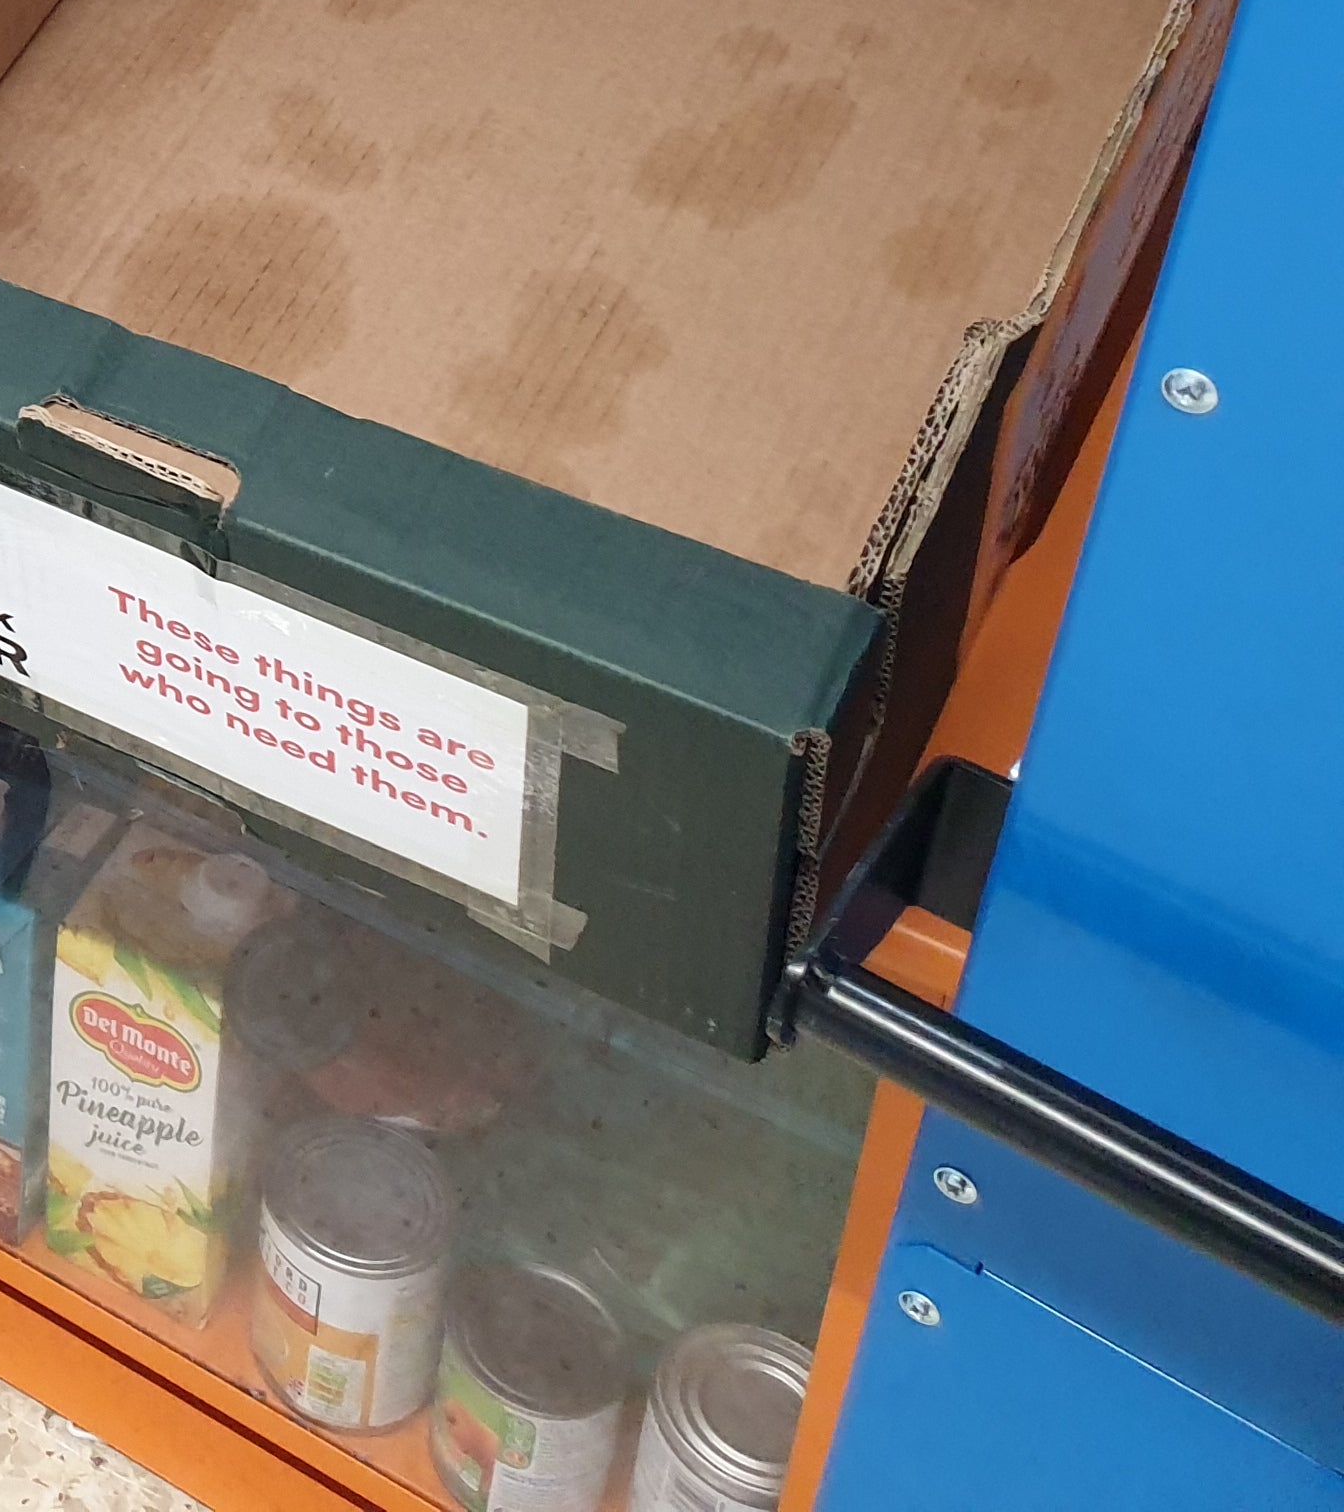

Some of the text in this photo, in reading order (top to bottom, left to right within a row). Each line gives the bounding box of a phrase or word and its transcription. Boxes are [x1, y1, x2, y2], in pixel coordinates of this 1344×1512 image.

[108, 586, 496, 770] These things are
[118, 662, 489, 840] who need them.
[136, 639, 468, 795] going to those
[83, 1006, 193, 1076] Del Monte
[56, 1079, 204, 1147] Pineapple
[91, 1076, 135, 1103] 100%
[83, 1124, 146, 1156] juice
